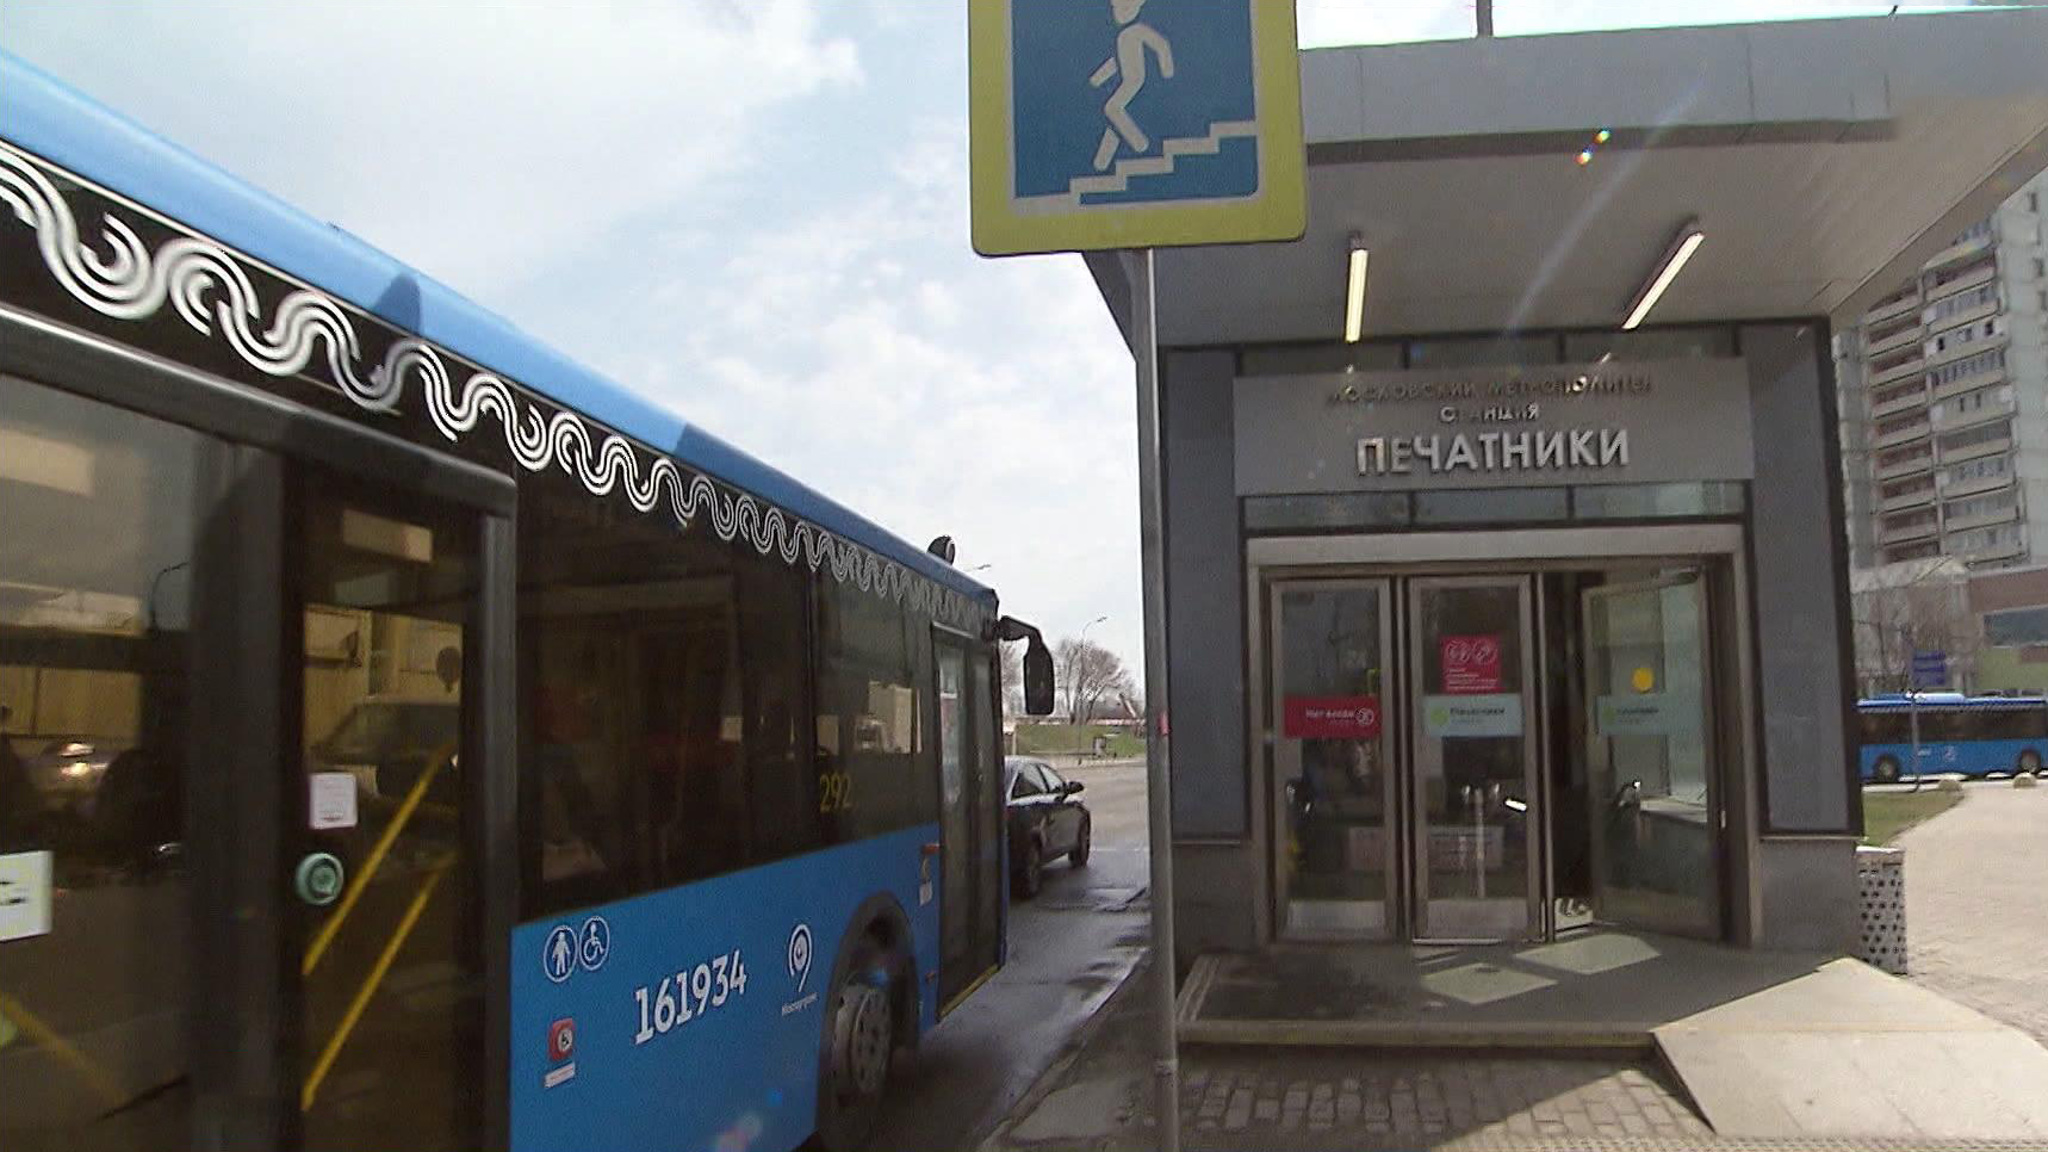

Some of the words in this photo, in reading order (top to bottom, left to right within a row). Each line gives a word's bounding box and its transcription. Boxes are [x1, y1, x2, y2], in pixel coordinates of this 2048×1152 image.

[1439, 401, 1541, 423] СНЦИЯ
[1356, 428, 1630, 475] ПЕЧАТНИКИ
[820, 773, 852, 812] 292
[634, 948, 747, 1046] 161934
